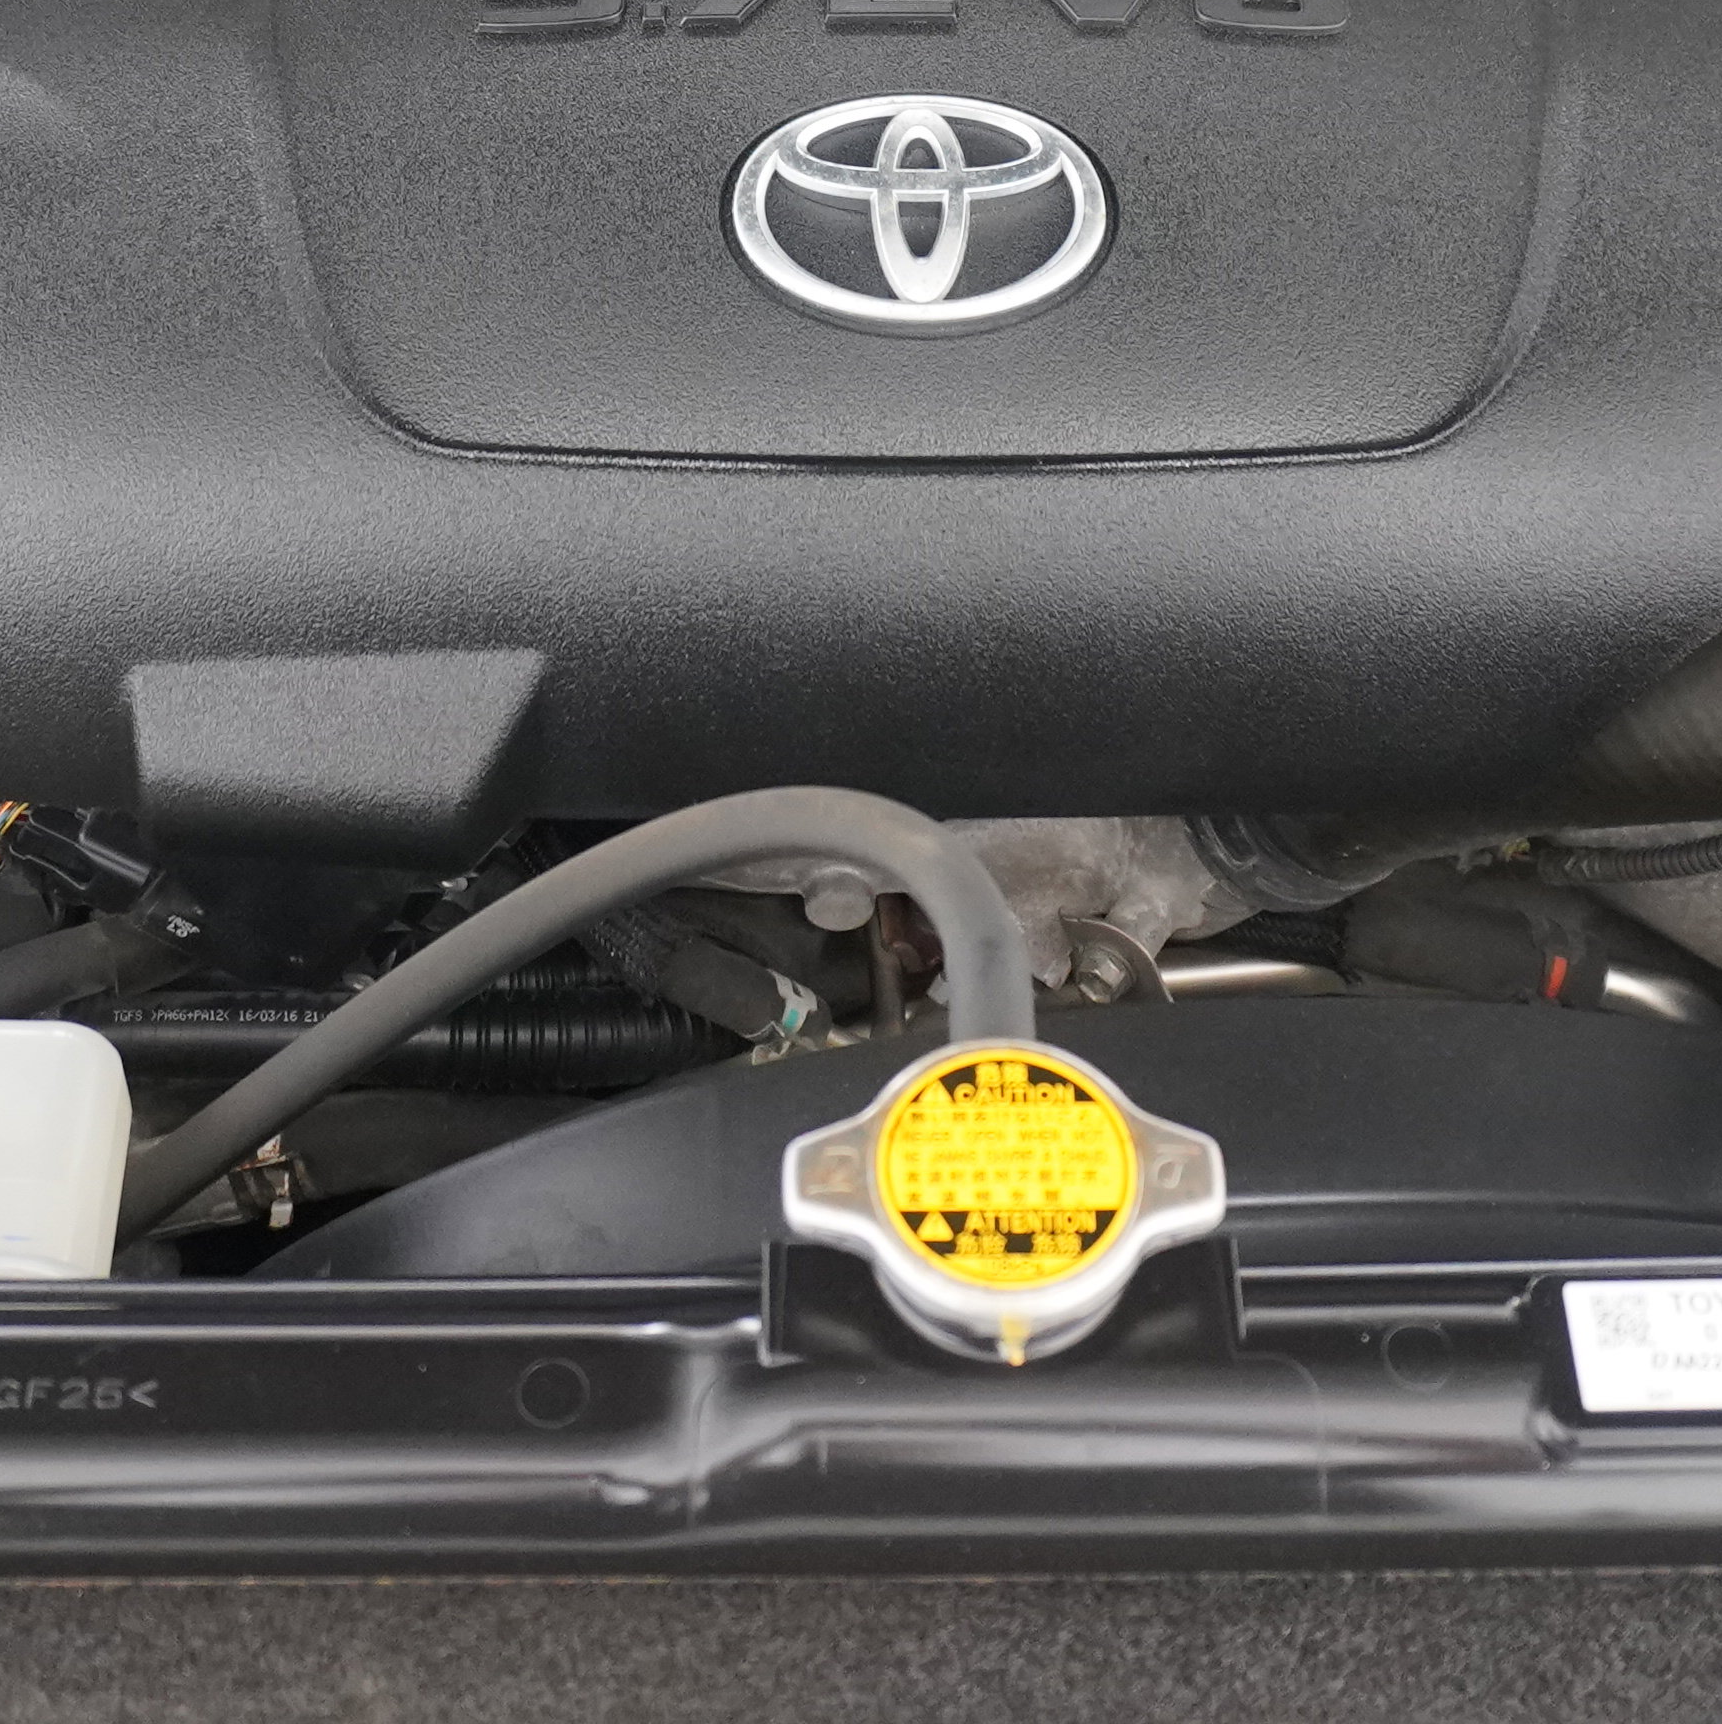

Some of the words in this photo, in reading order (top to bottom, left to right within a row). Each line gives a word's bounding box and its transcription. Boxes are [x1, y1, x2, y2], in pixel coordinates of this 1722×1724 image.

[239, 1010, 298, 1022] 16/03/16
[954, 1081, 1075, 1103] CAUTION
[964, 1210, 1098, 1235] ATTENTION
